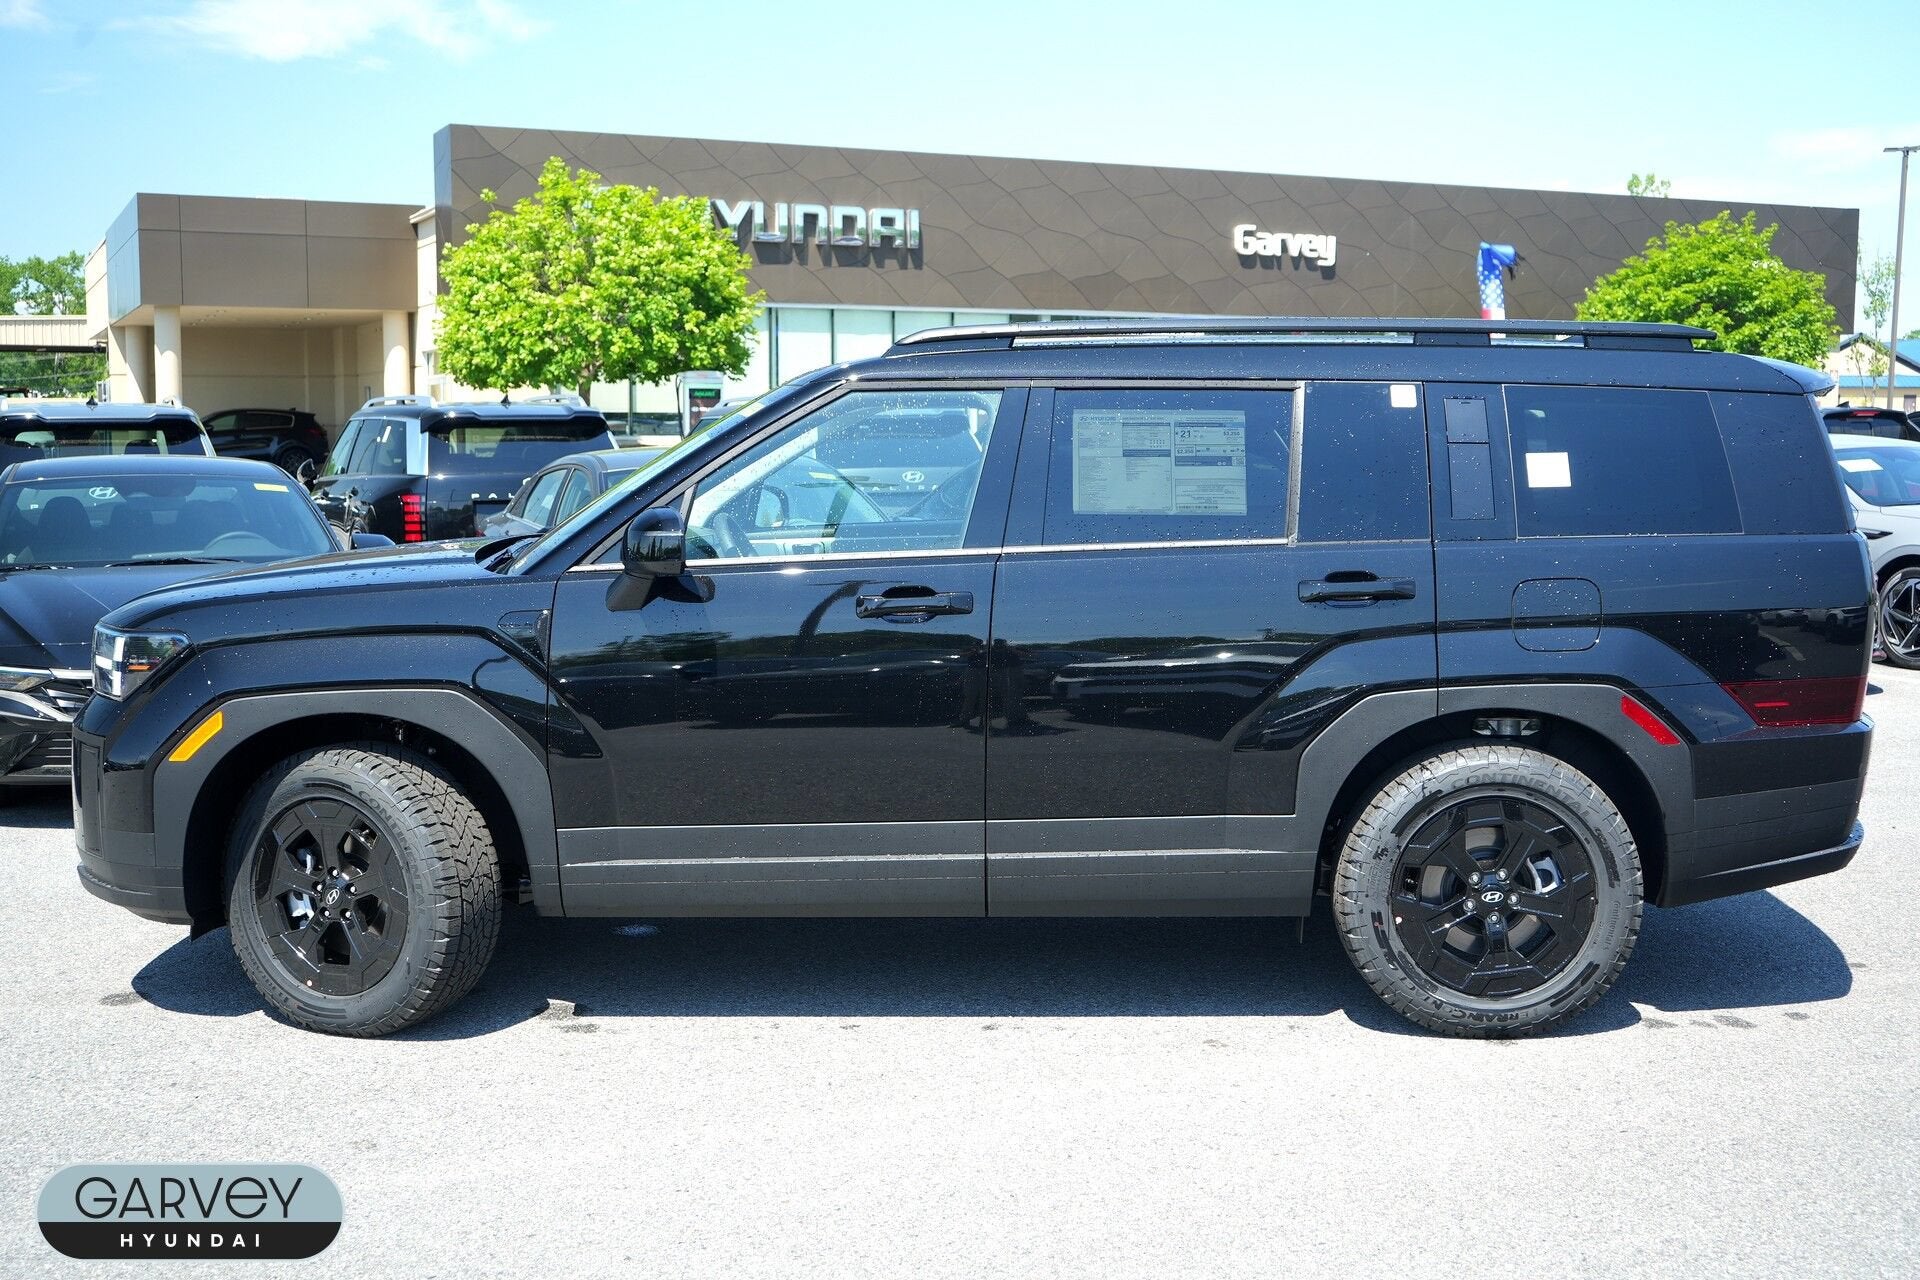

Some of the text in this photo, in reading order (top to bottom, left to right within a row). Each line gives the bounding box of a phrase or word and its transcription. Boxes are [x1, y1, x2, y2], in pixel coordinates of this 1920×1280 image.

[705, 199, 920, 249] YUNDAI
[1233, 224, 1337, 267] Garvey
[1180, 430, 1191, 438] 21
